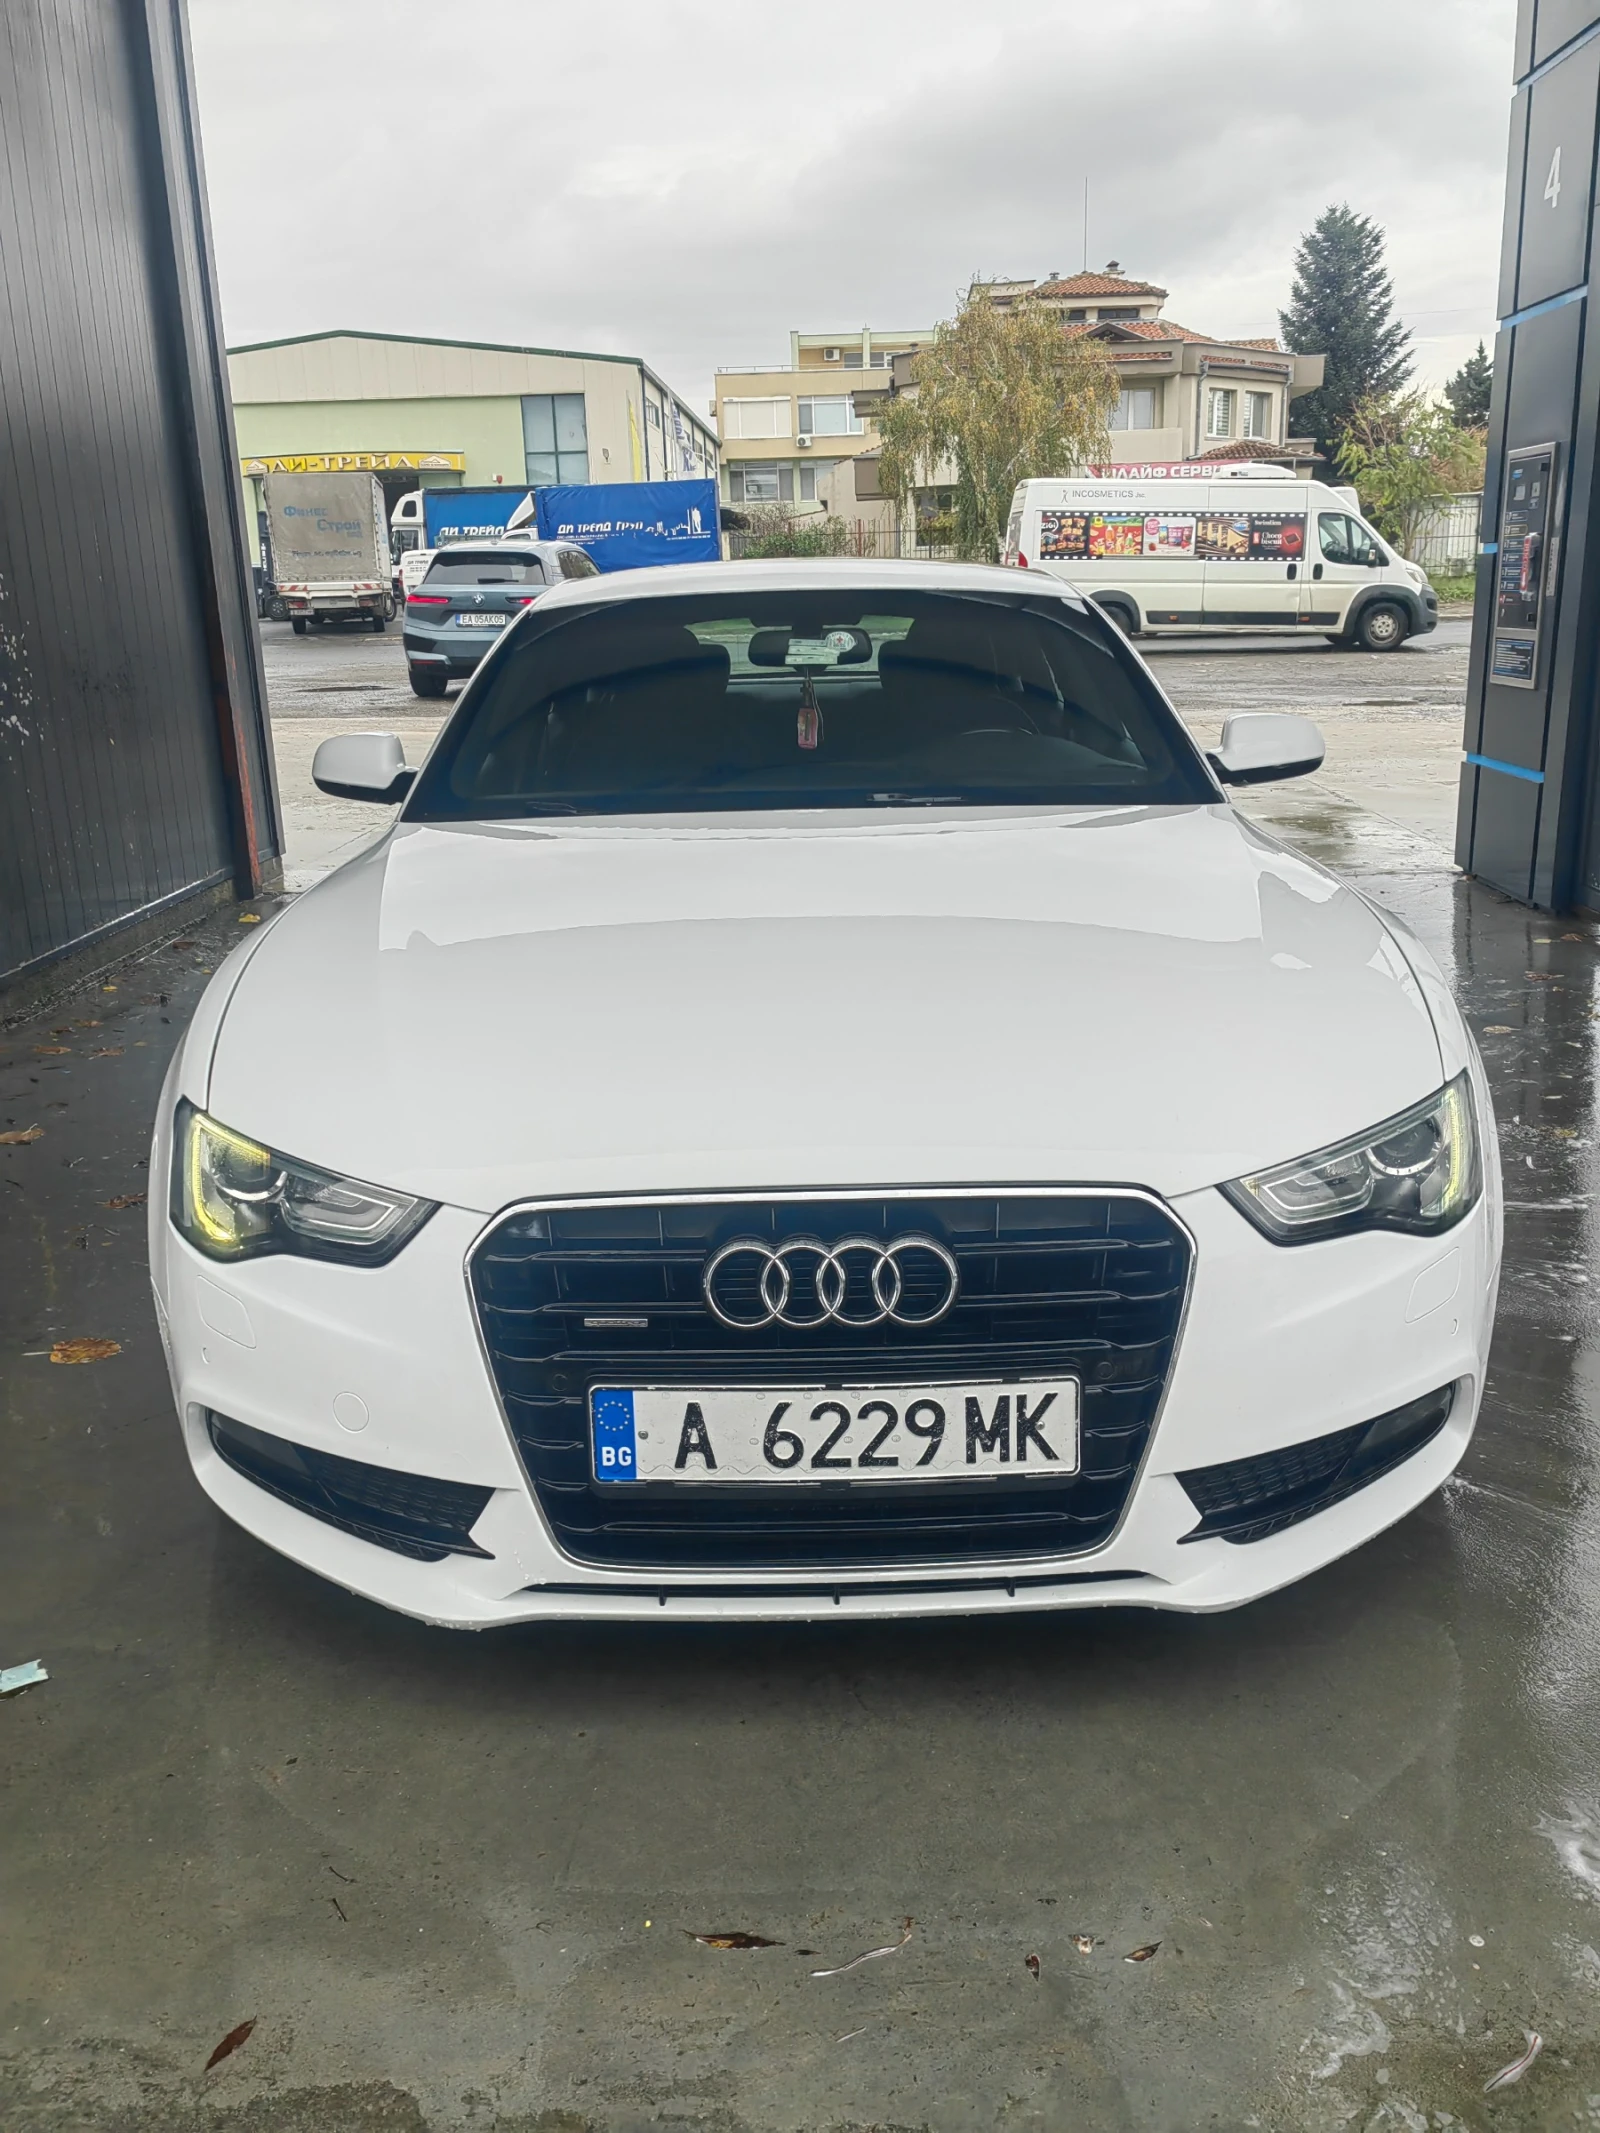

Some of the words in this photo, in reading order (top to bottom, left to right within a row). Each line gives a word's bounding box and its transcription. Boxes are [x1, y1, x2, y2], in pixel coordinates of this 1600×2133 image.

[1544, 145, 1561, 209] 4
[271, 453, 415, 473] ДИ-ТРЕЙД
[1170, 464, 1222, 479] СЕРВИ
[1072, 489, 1134, 498] INCOSMETICS
[601, 1446, 632, 1467] BG
[674, 1401, 718, 1469] A
[763, 1397, 946, 1469] 6229
[964, 1392, 1061, 1464] MK
